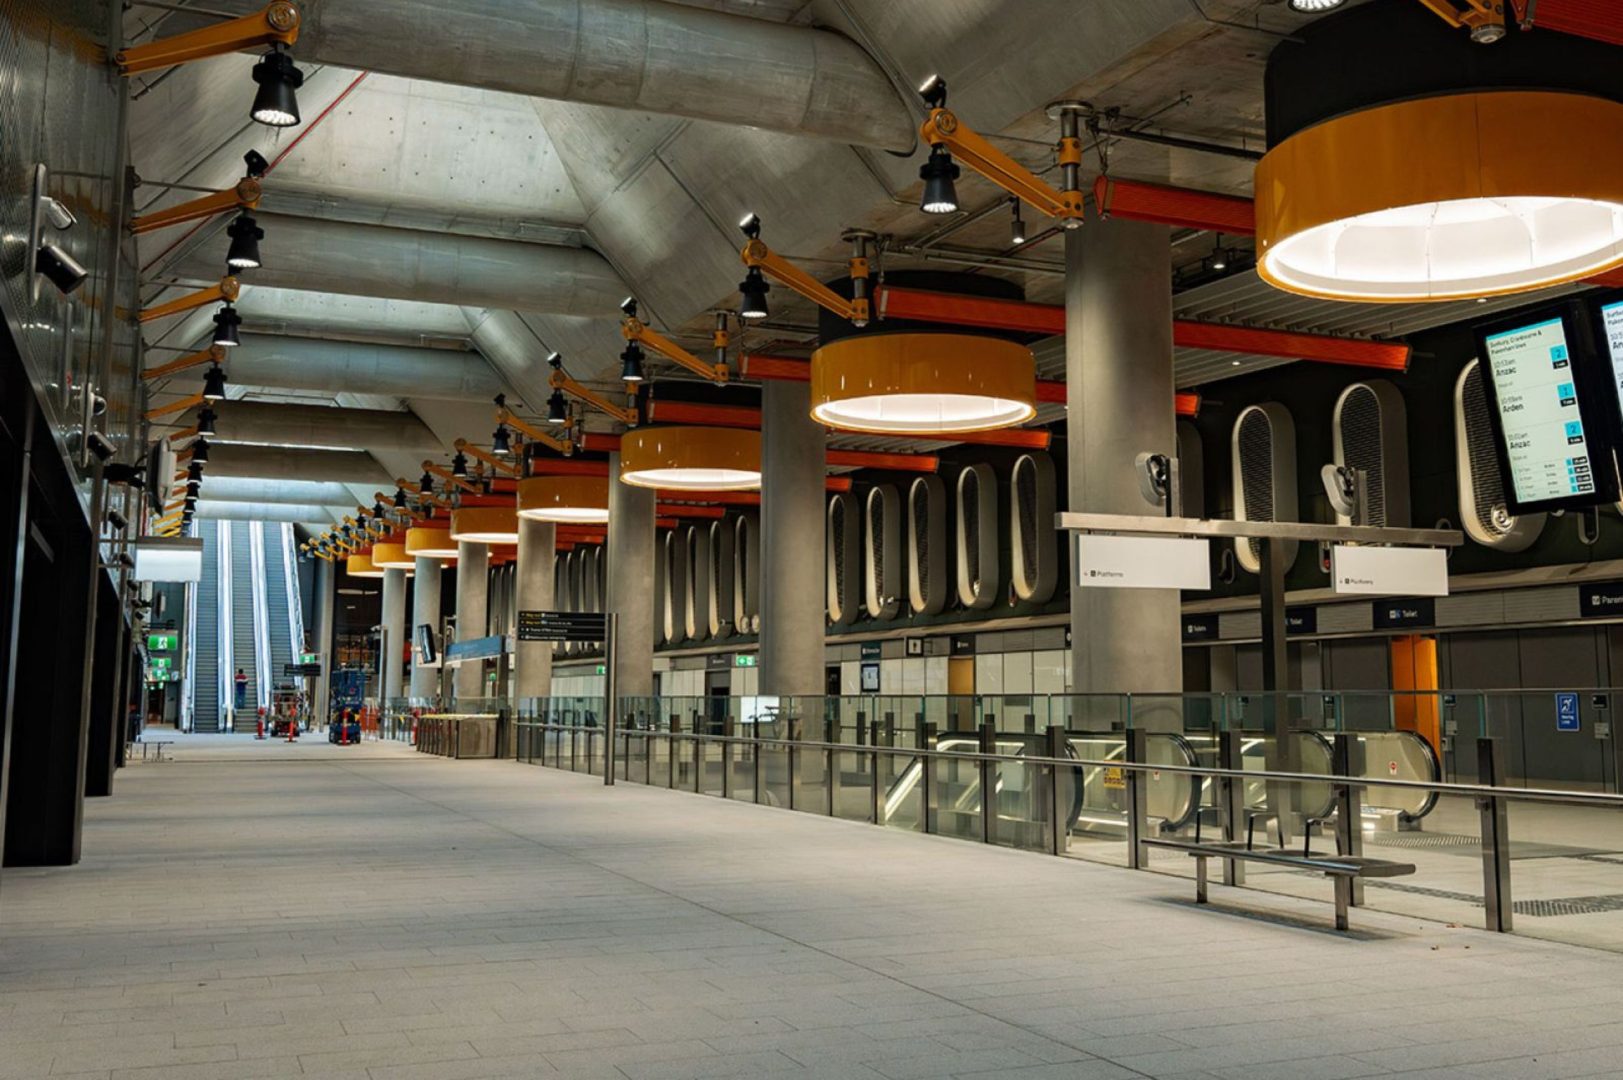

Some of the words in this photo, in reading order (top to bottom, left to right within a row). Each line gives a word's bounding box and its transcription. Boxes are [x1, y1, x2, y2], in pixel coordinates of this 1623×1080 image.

[1496, 367, 1517, 377] Anzac
[1503, 403, 1524, 413] Arden
[1510, 439, 1531, 450] Anzac
